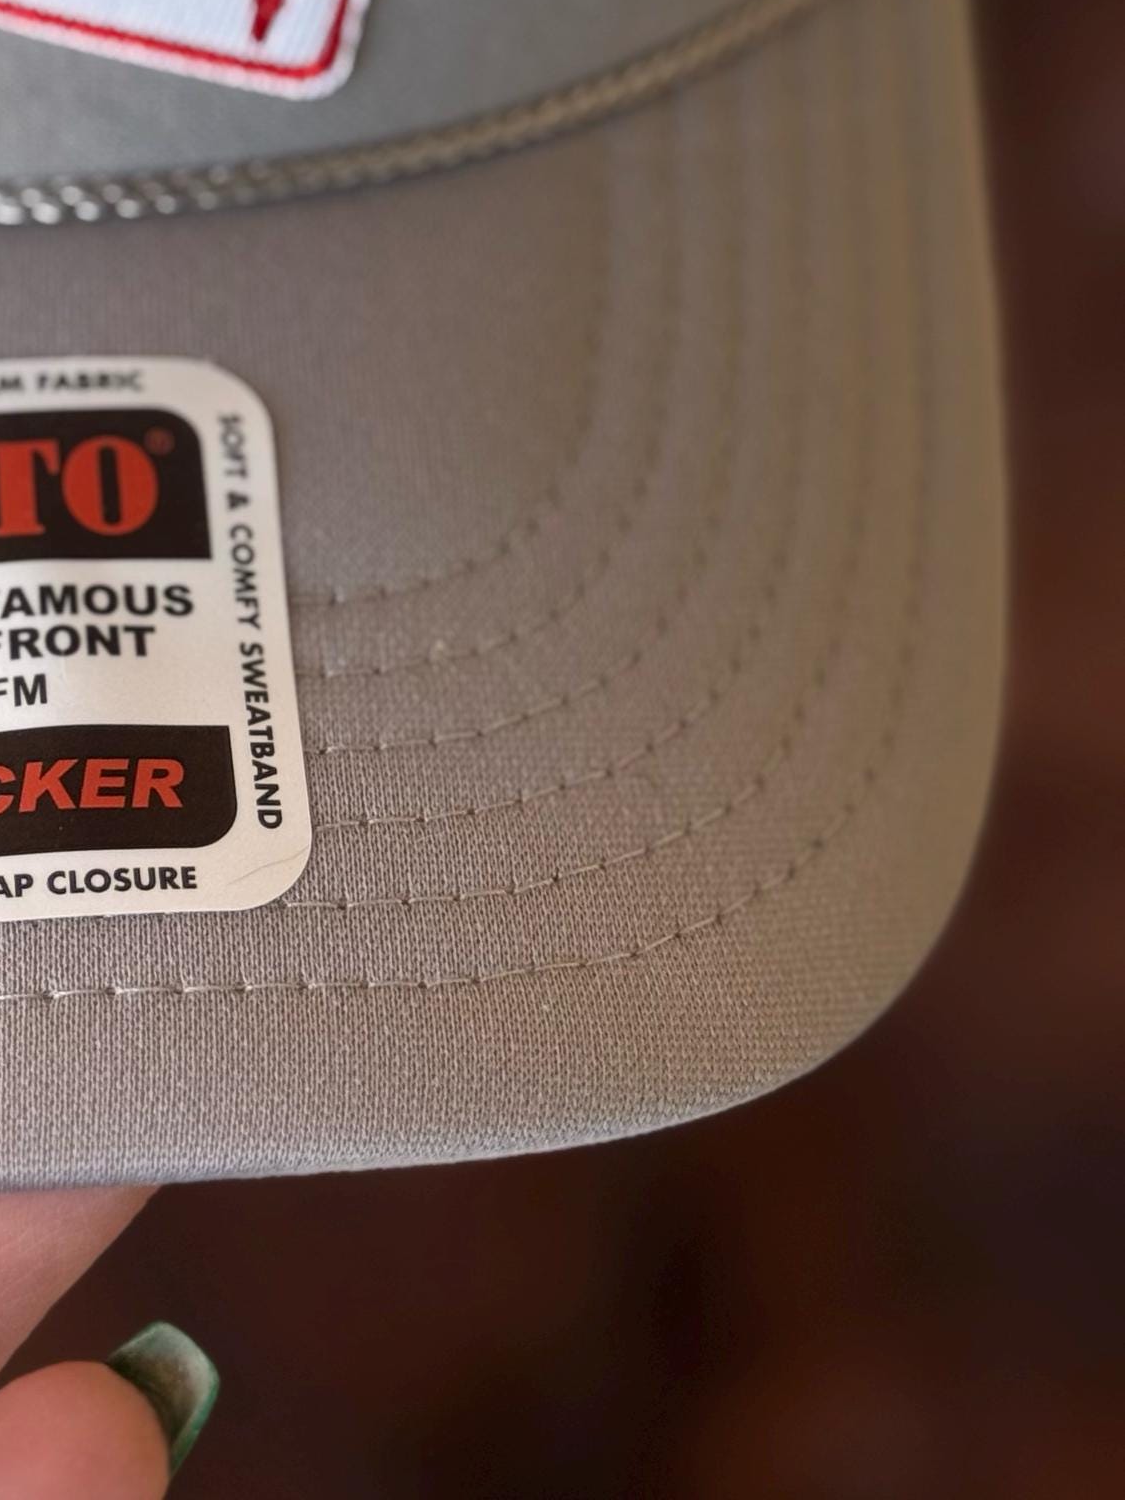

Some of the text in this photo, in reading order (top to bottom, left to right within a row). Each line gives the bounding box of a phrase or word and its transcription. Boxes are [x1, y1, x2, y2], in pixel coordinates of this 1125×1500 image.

[37, 369, 145, 392] FABRIC
[218, 412, 283, 830] SOFT & COMFY SWEATBAND
[46, 866, 197, 895] CLOSURE
